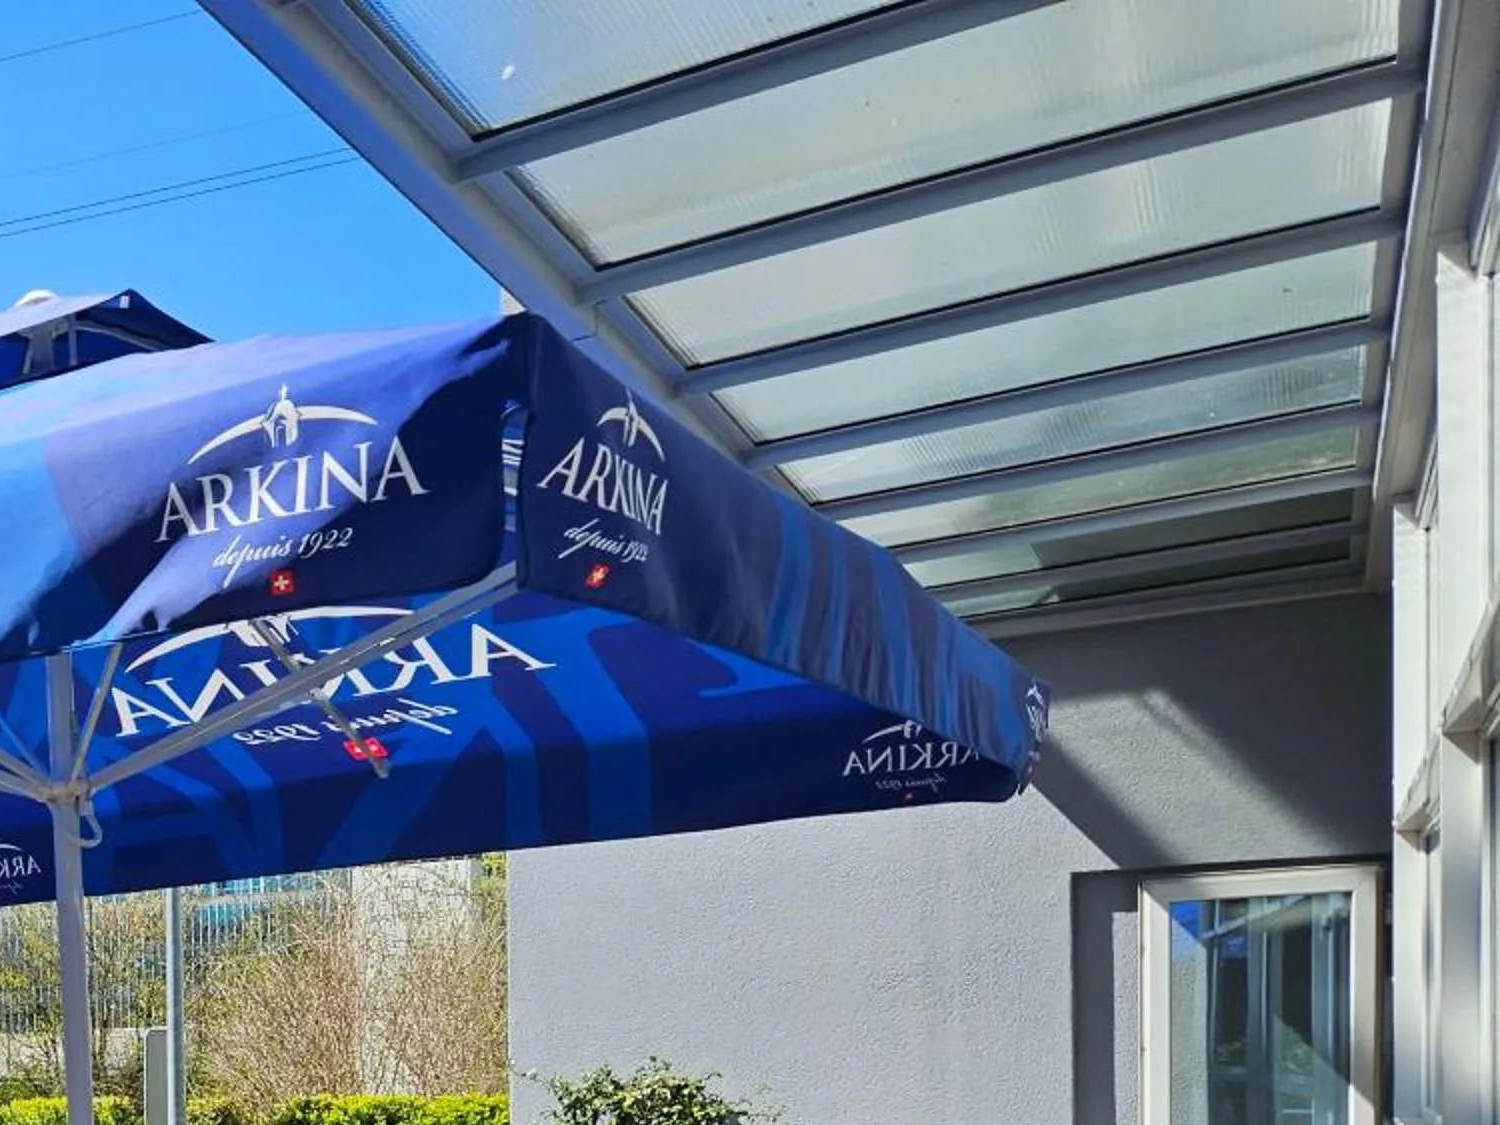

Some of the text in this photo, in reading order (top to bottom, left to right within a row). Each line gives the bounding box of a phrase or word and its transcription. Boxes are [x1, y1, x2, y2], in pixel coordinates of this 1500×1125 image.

[153, 435, 430, 543] ARKINA
[536, 436, 669, 536] ARKINA
[211, 526, 354, 589] depuis 1922
[557, 517, 624, 560] depuis
